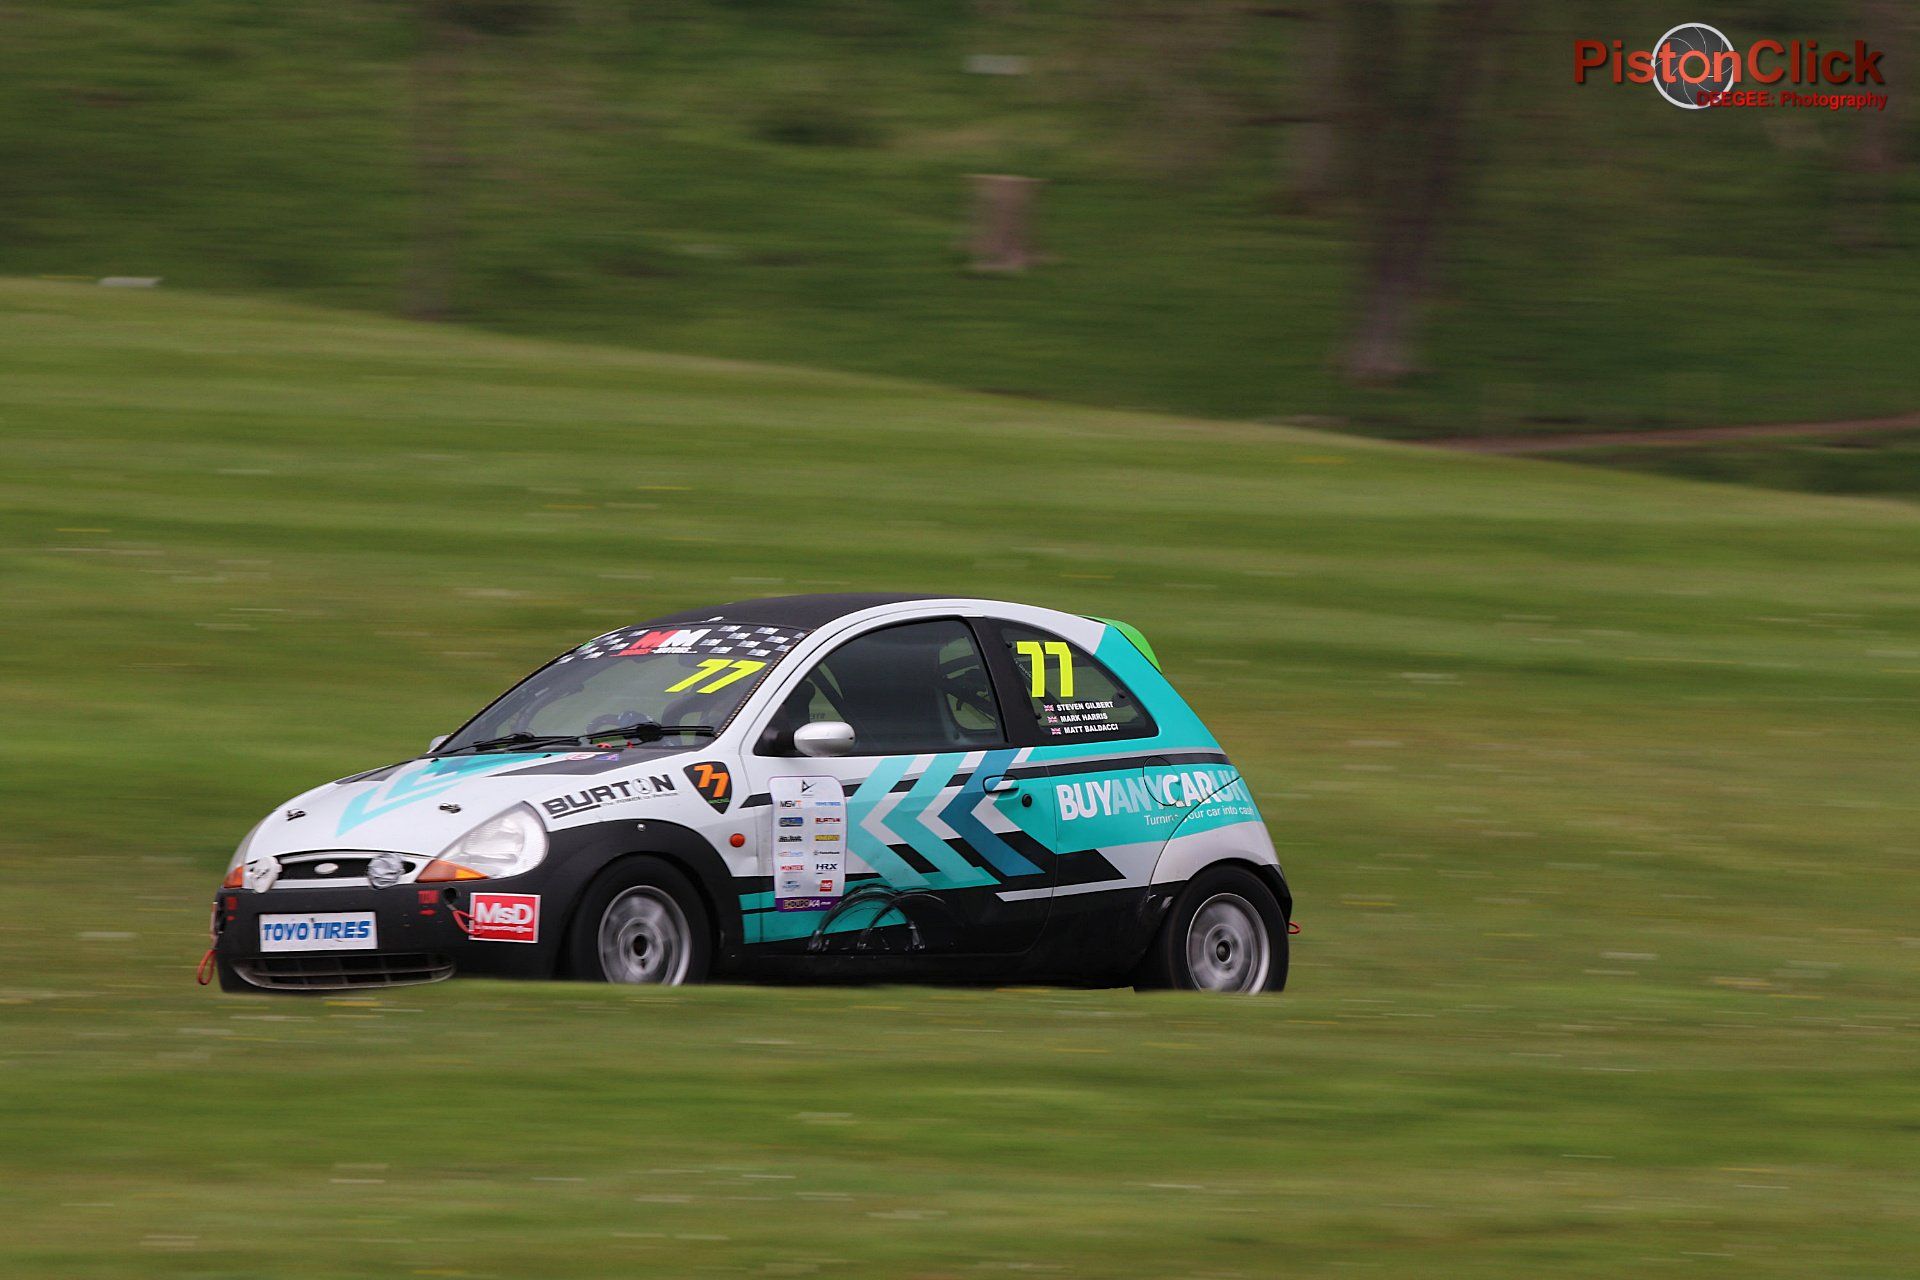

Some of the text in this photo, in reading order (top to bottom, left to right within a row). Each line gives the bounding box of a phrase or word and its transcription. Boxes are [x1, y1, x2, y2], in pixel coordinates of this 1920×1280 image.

[664, 658, 767, 694] 77
[1016, 641, 1074, 697] 77
[1056, 701, 1114, 712] STEVEN GILBERT
[1060, 713, 1108, 723] MARK HARRIS
[1064, 723, 1119, 734] MATT BALDACCI
[694, 765, 729, 798] 77
[541, 774, 676, 815] BURTON
[1206, 808, 1221, 816] car
[1222, 804, 1238, 815] into
[475, 902, 533, 924] MsD
[264, 920, 371, 941] TOYO TIRES
